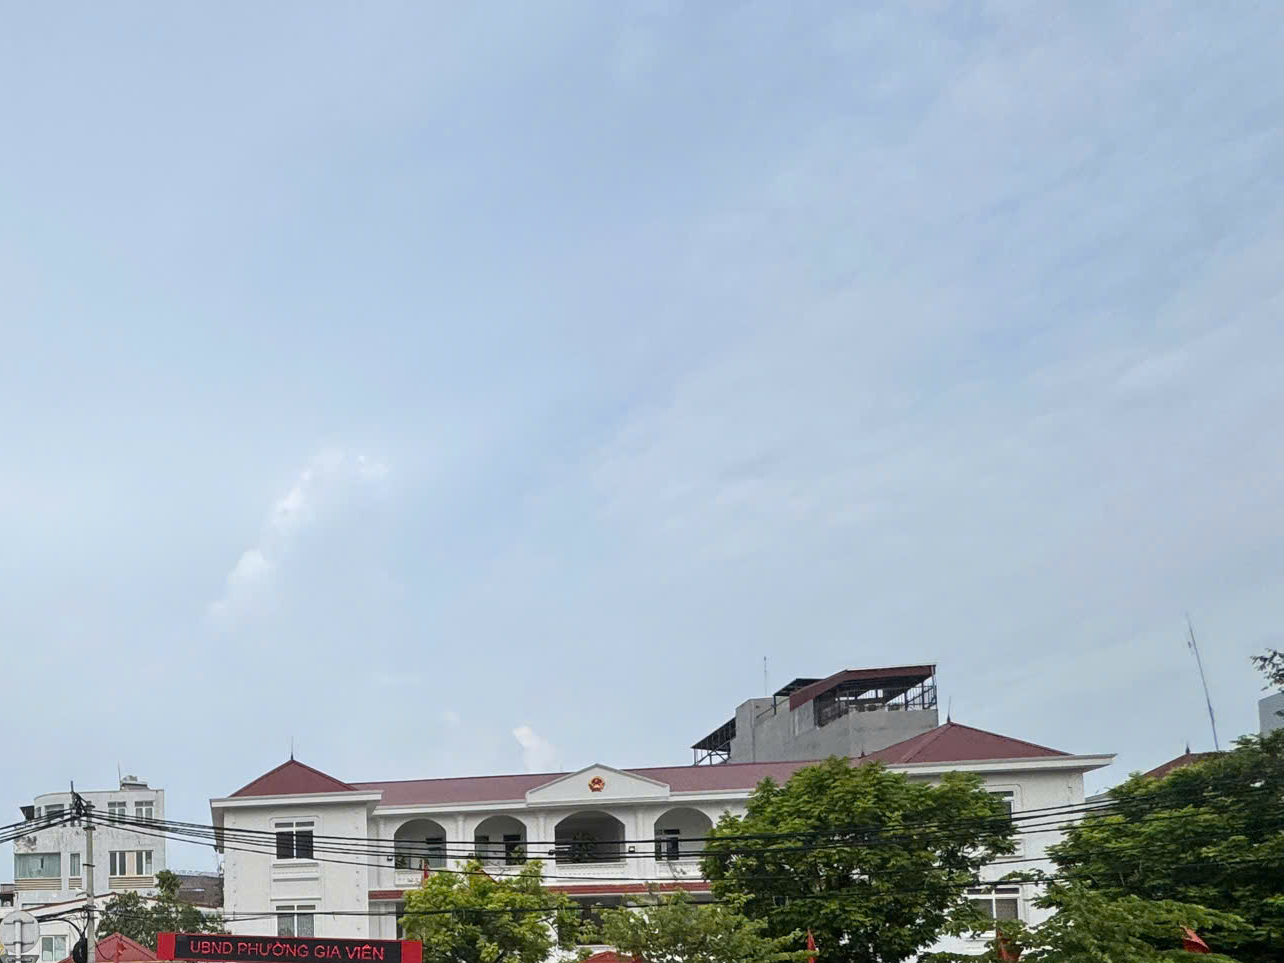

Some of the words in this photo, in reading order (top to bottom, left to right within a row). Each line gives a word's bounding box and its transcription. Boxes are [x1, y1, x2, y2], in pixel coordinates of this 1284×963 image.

[190, 940, 234, 954] UBND
[237, 941, 309, 957] PHƯỜNG
[313, 945, 342, 959] GIA
[345, 945, 386, 961] VIÊN
